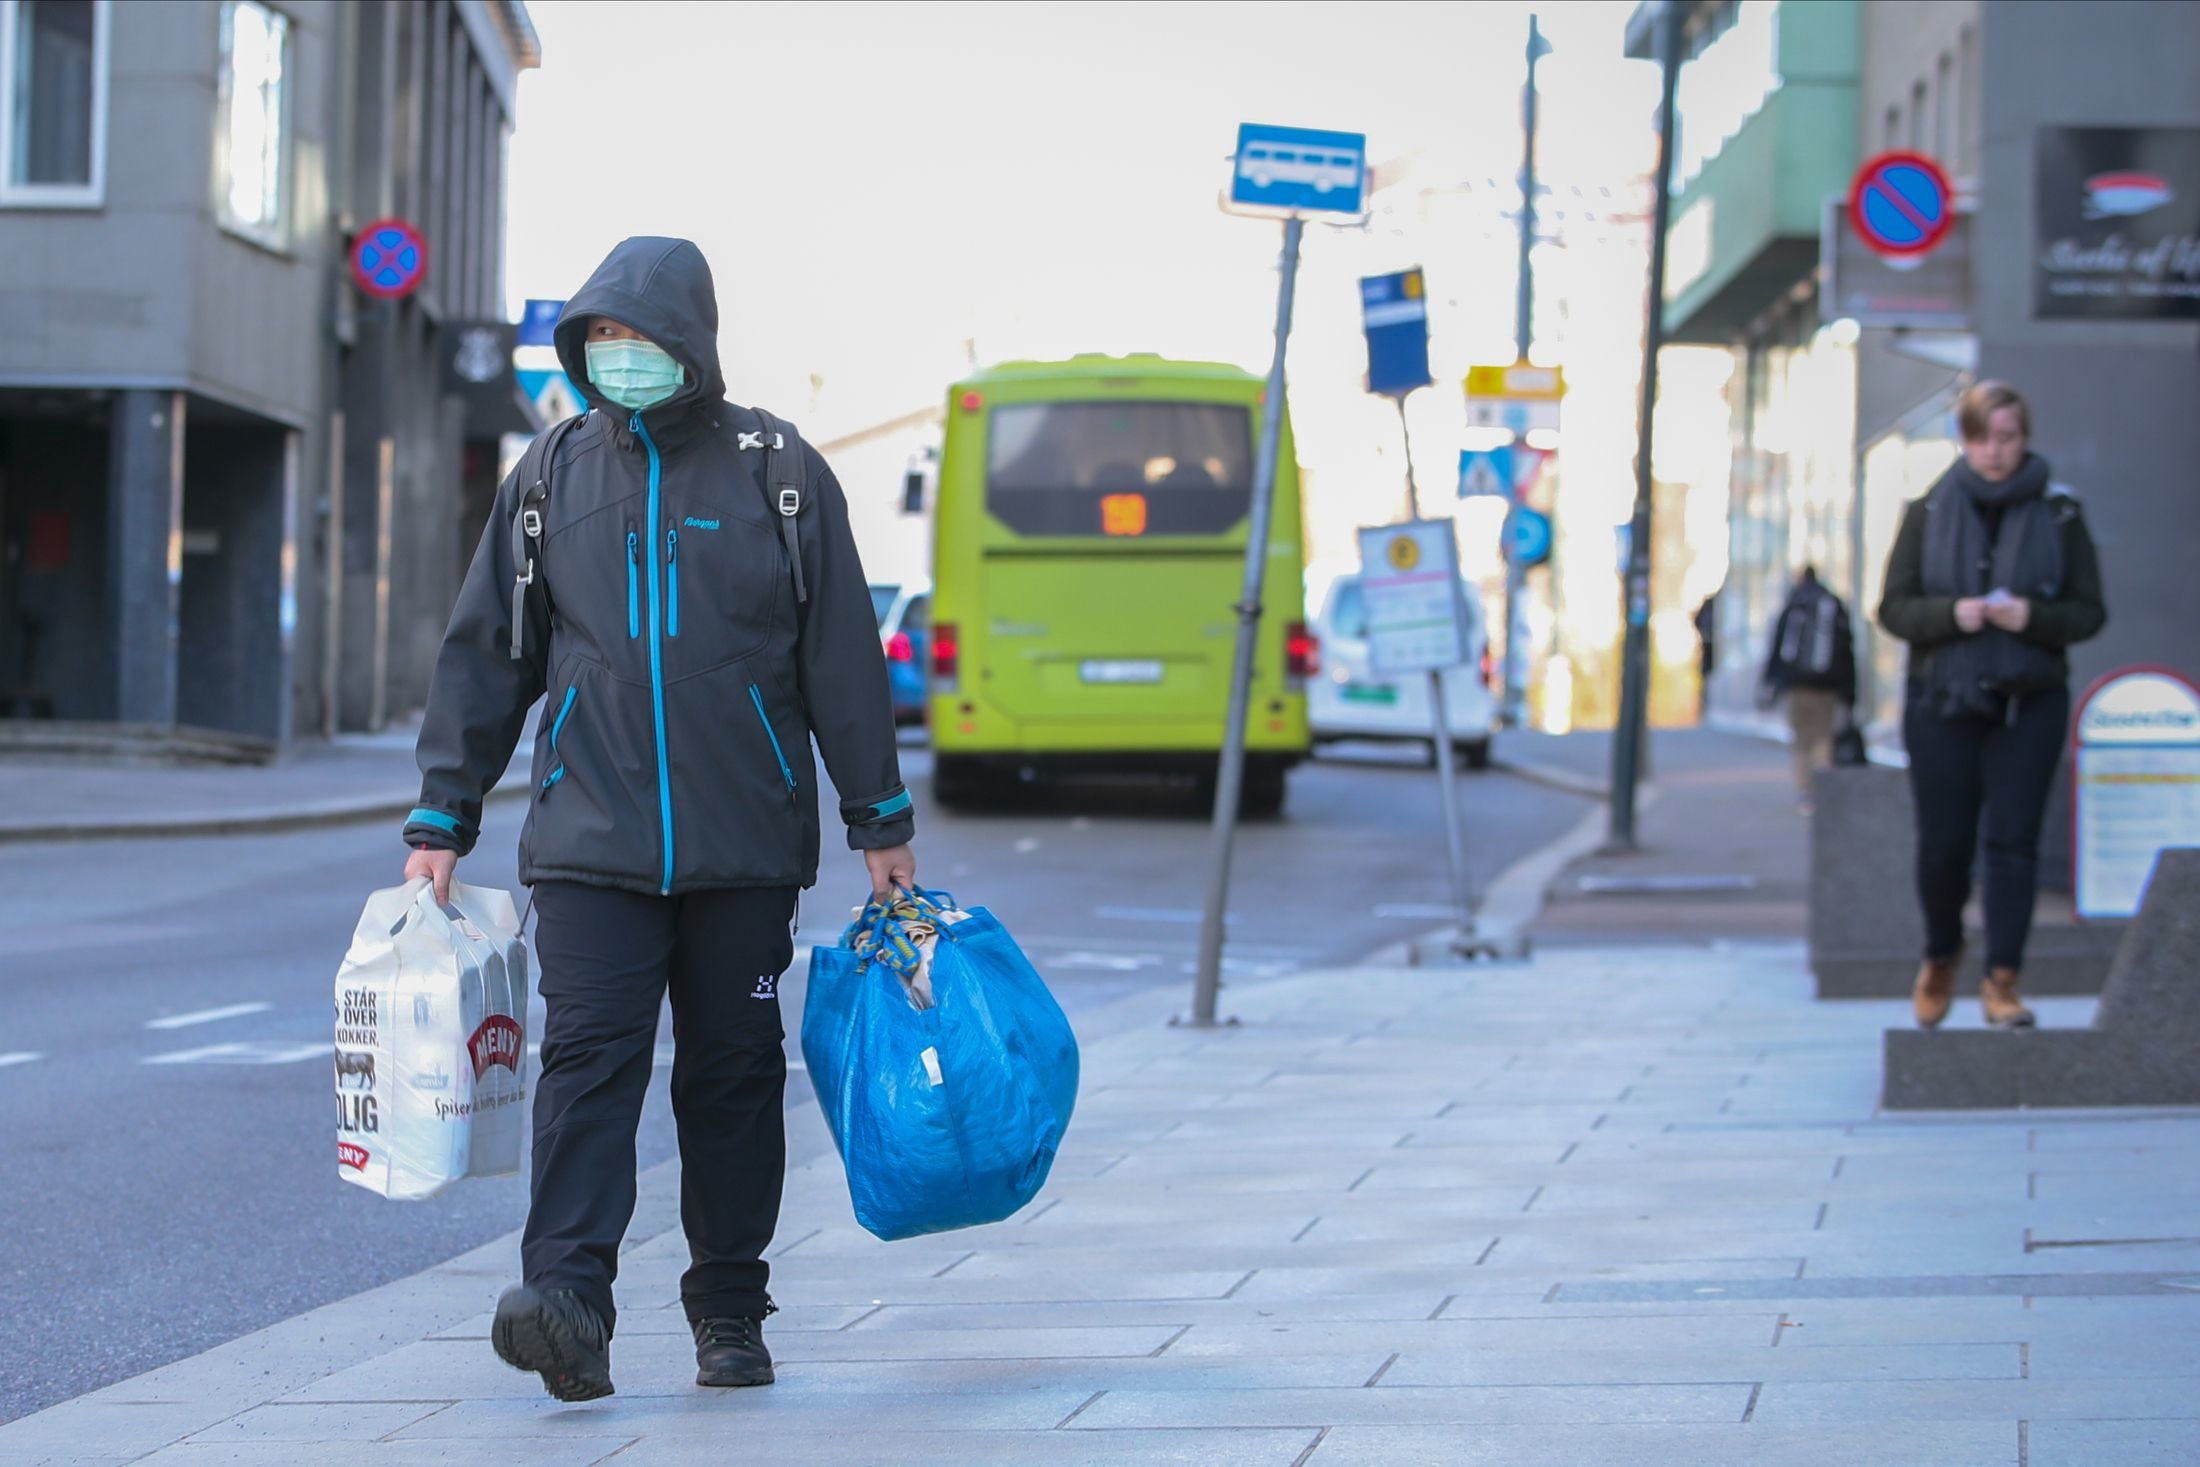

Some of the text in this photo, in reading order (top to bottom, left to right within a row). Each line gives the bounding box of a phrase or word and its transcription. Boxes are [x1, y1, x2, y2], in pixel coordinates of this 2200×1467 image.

[476, 1027, 517, 1065] MENY
[434, 1096, 471, 1121] Spiser
[338, 1146, 365, 1166] ENY
